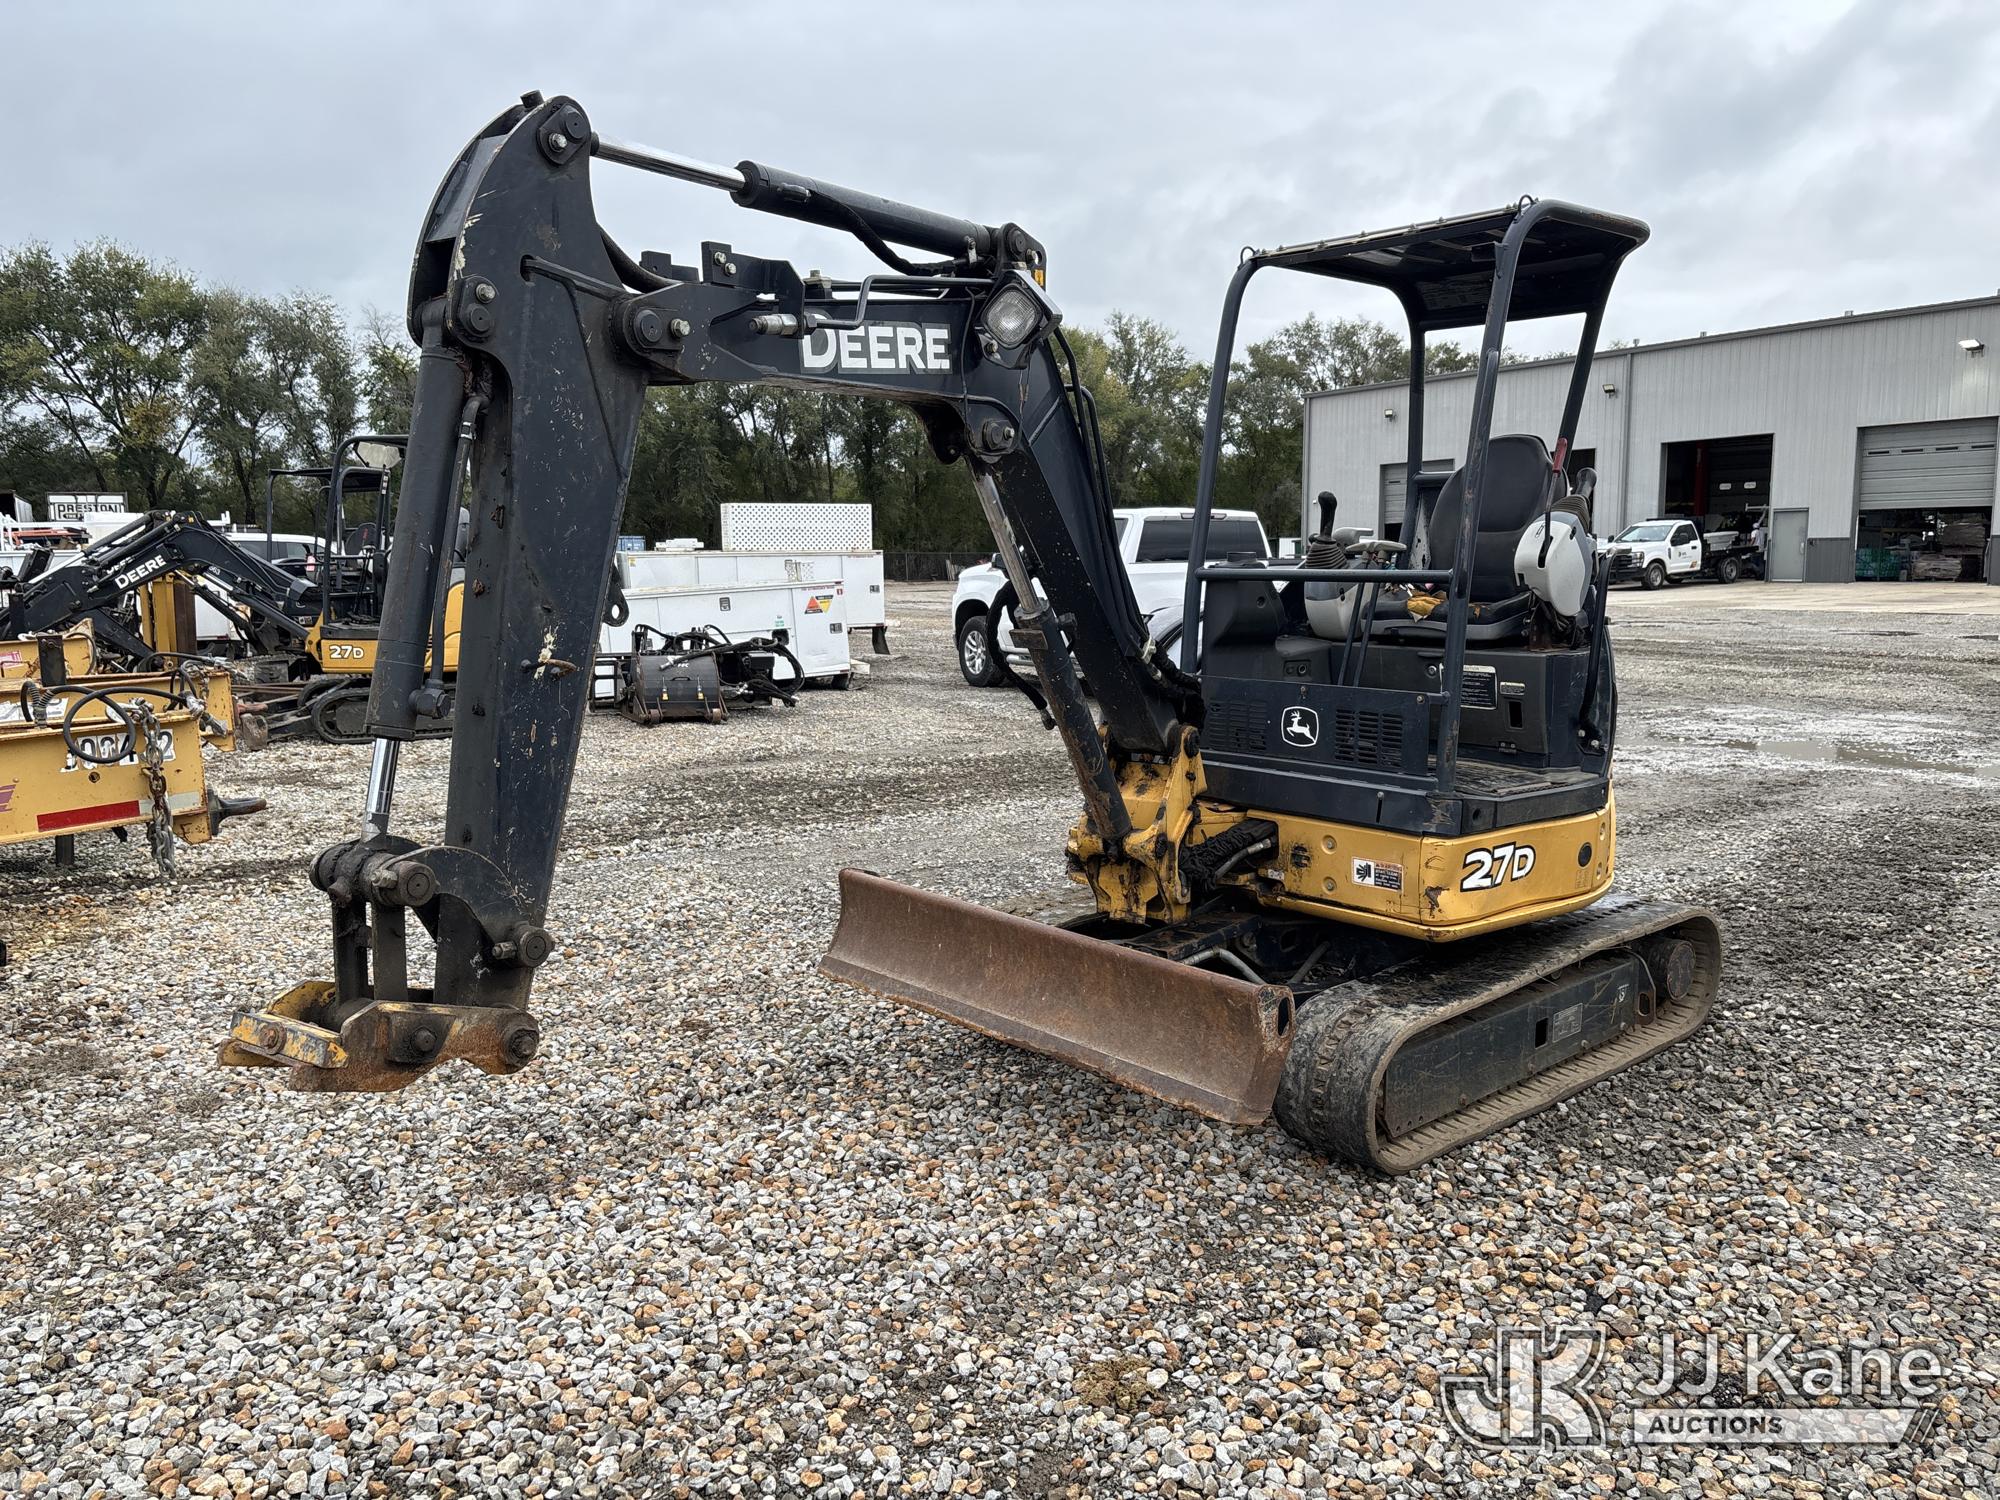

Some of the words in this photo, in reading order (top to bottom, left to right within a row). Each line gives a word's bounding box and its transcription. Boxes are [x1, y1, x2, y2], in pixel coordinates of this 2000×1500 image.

[803, 317, 950, 369] DEERE
[57, 504, 118, 519] PRESTON
[115, 554, 167, 589] DEERE
[329, 644, 364, 659] 27D
[1461, 843, 1536, 891] 27D
